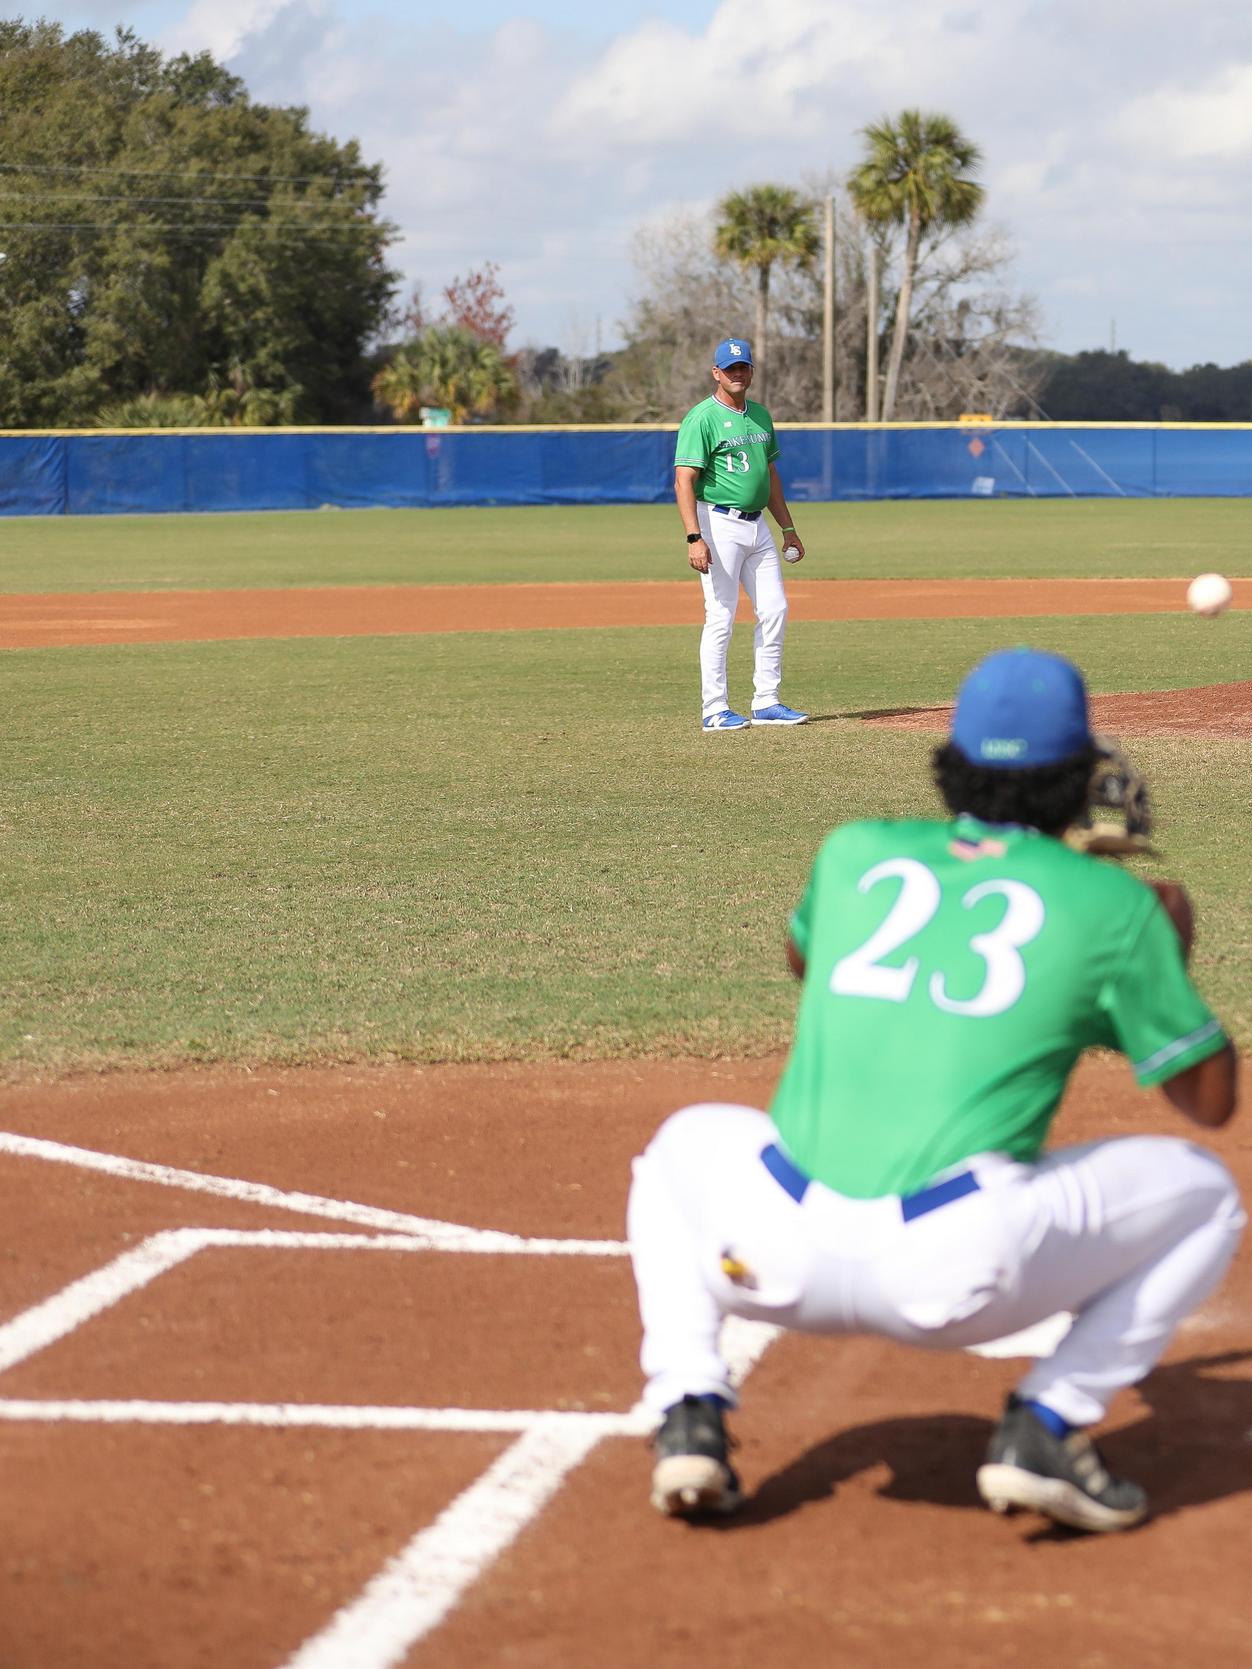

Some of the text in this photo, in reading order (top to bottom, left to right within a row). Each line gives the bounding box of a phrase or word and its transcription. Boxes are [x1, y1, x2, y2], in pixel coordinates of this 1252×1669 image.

[729, 343, 742, 356] LS
[726, 450, 750, 473] 13
[829, 857, 1045, 1018] 23
